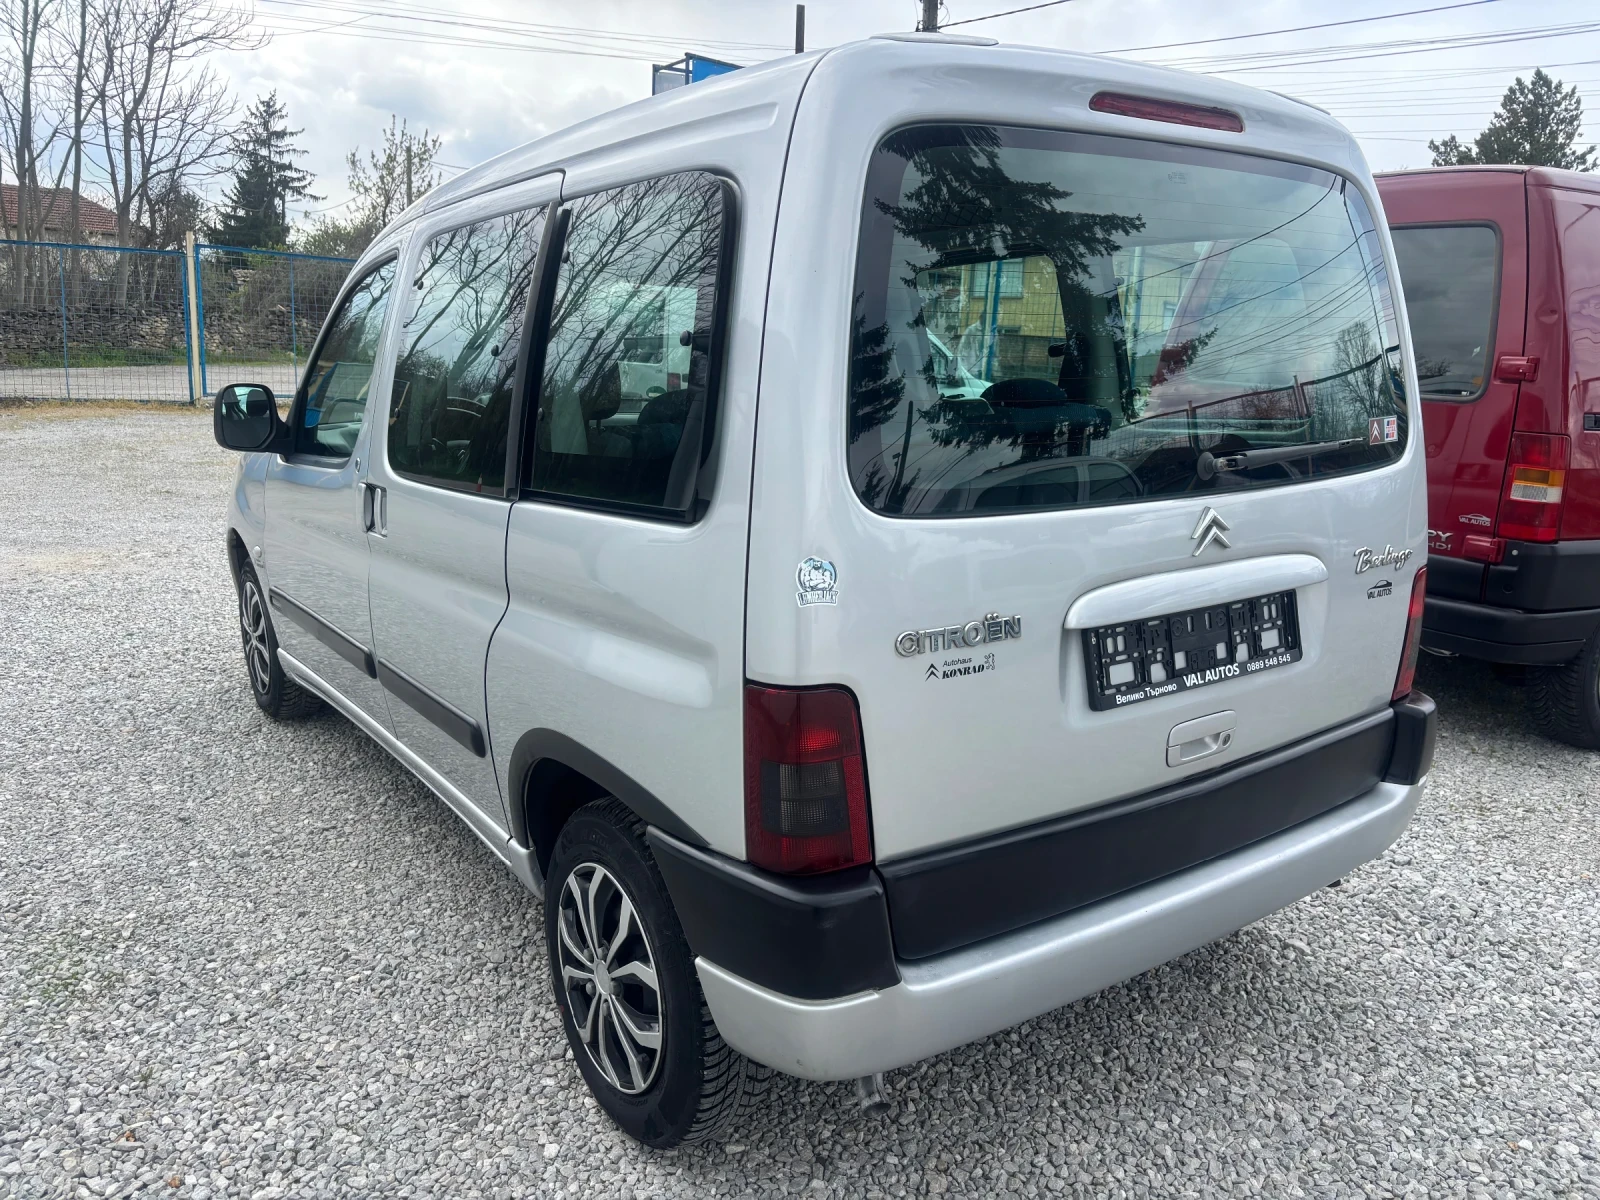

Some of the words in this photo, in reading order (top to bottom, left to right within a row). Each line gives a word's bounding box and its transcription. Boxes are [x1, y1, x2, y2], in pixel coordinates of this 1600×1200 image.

[1353, 544, 1413, 574] Berlingo
[1377, 587, 1392, 598] AUTOS
[895, 612, 1021, 658] CITROËN
[942, 656, 973, 668] Autohaus
[942, 664, 984, 680] KONRAD
[1246, 660, 1264, 672] 0889
[1265, 656, 1278, 667] 548
[1278, 653, 1291, 664] 545
[1183, 672, 1204, 687] VAL
[1205, 663, 1240, 683] AUTOS
[1115, 691, 1145, 705] Велико
[1145, 683, 1178, 697] Търново
